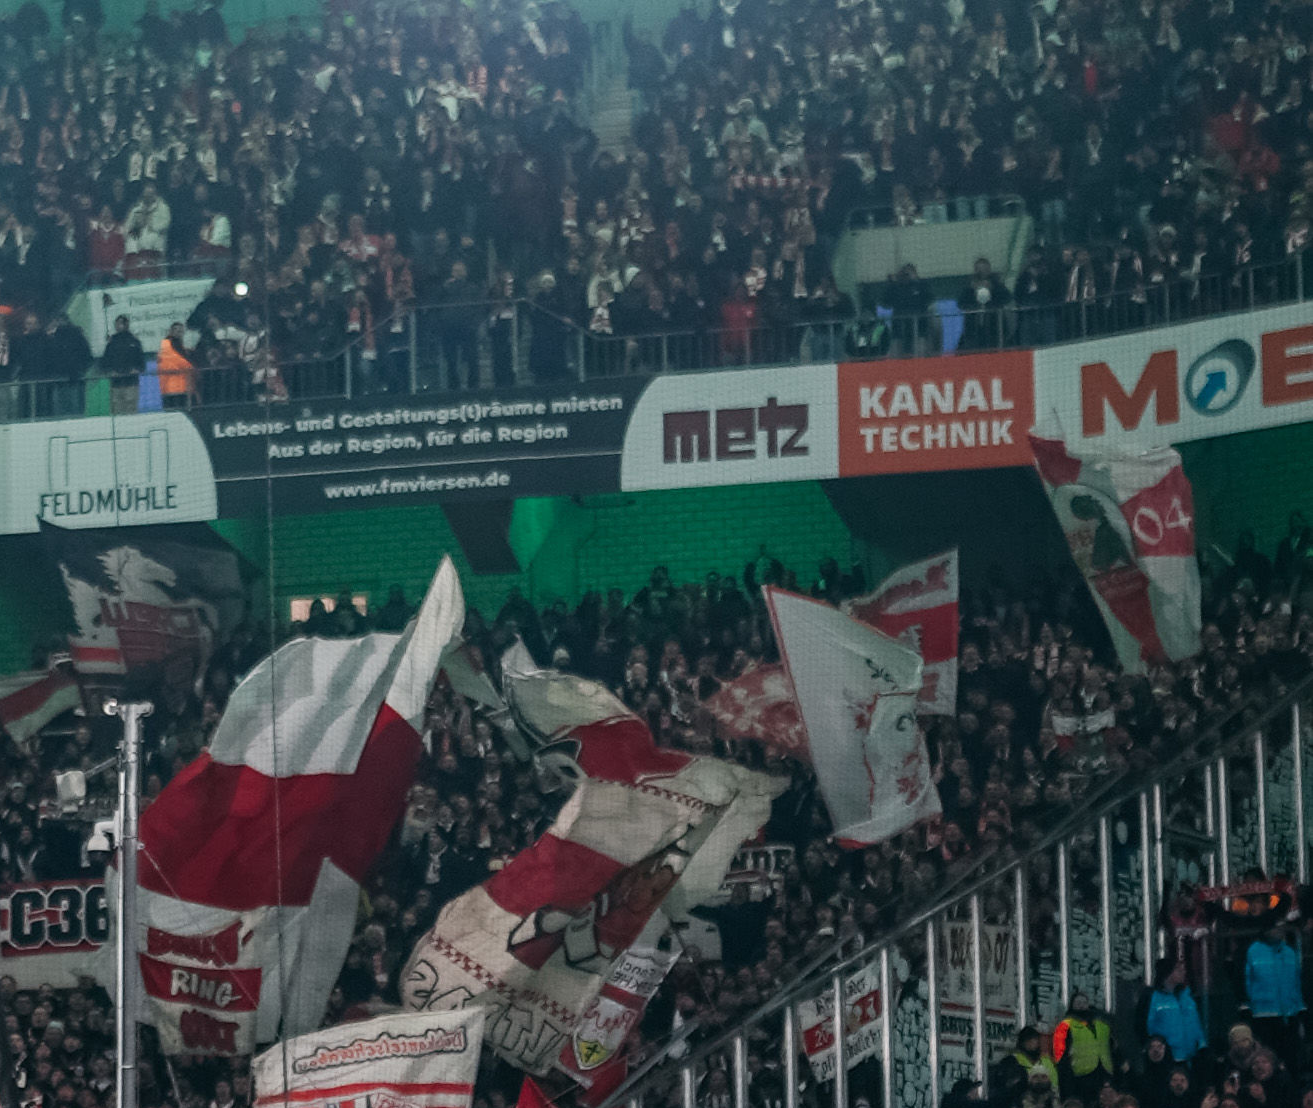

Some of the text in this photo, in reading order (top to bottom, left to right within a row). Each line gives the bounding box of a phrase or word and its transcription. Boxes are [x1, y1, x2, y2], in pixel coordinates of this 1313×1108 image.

[214, 418, 292, 438] Lebens-
[296, 413, 334, 434] und
[551, 396, 623, 415] mieten
[859, 377, 1014, 420] KANAL
[268, 422, 568, 460] Aus der Region, für die Region
[662, 397, 809, 465] metz
[860, 420, 1013, 453] TECHNIK
[41, 483, 178, 518] FELDMÜHLE
[324, 472, 511, 499] www.fmviersen.de
[171, 969, 242, 1007] RING
